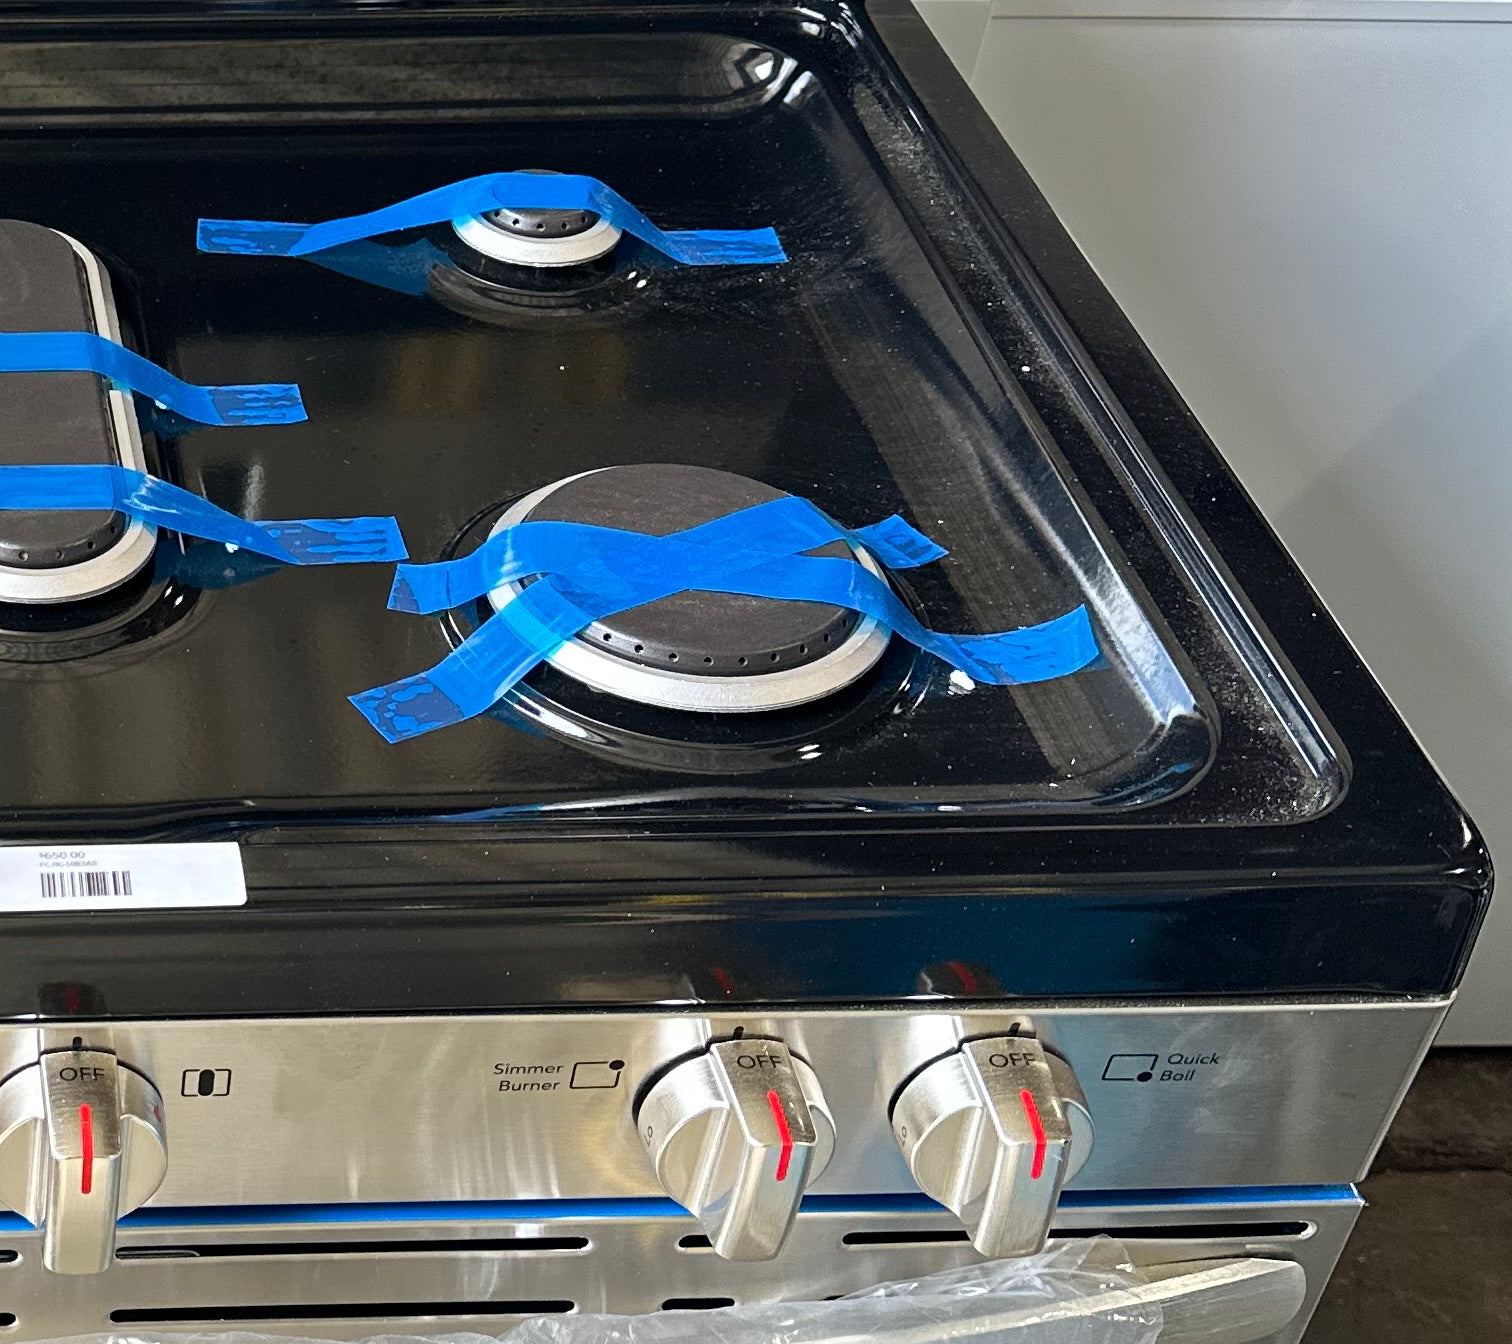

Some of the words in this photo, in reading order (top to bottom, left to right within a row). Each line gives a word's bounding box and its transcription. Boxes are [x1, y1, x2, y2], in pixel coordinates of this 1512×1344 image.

[737, 1055, 783, 1068] OFF
[988, 1052, 1038, 1069] OFF
[1167, 1052, 1221, 1067] Quick
[60, 1067, 104, 1081] OFF
[493, 1062, 564, 1075] Simmer
[1160, 1069, 1196, 1081] Boil
[498, 1080, 561, 1091] Burner
